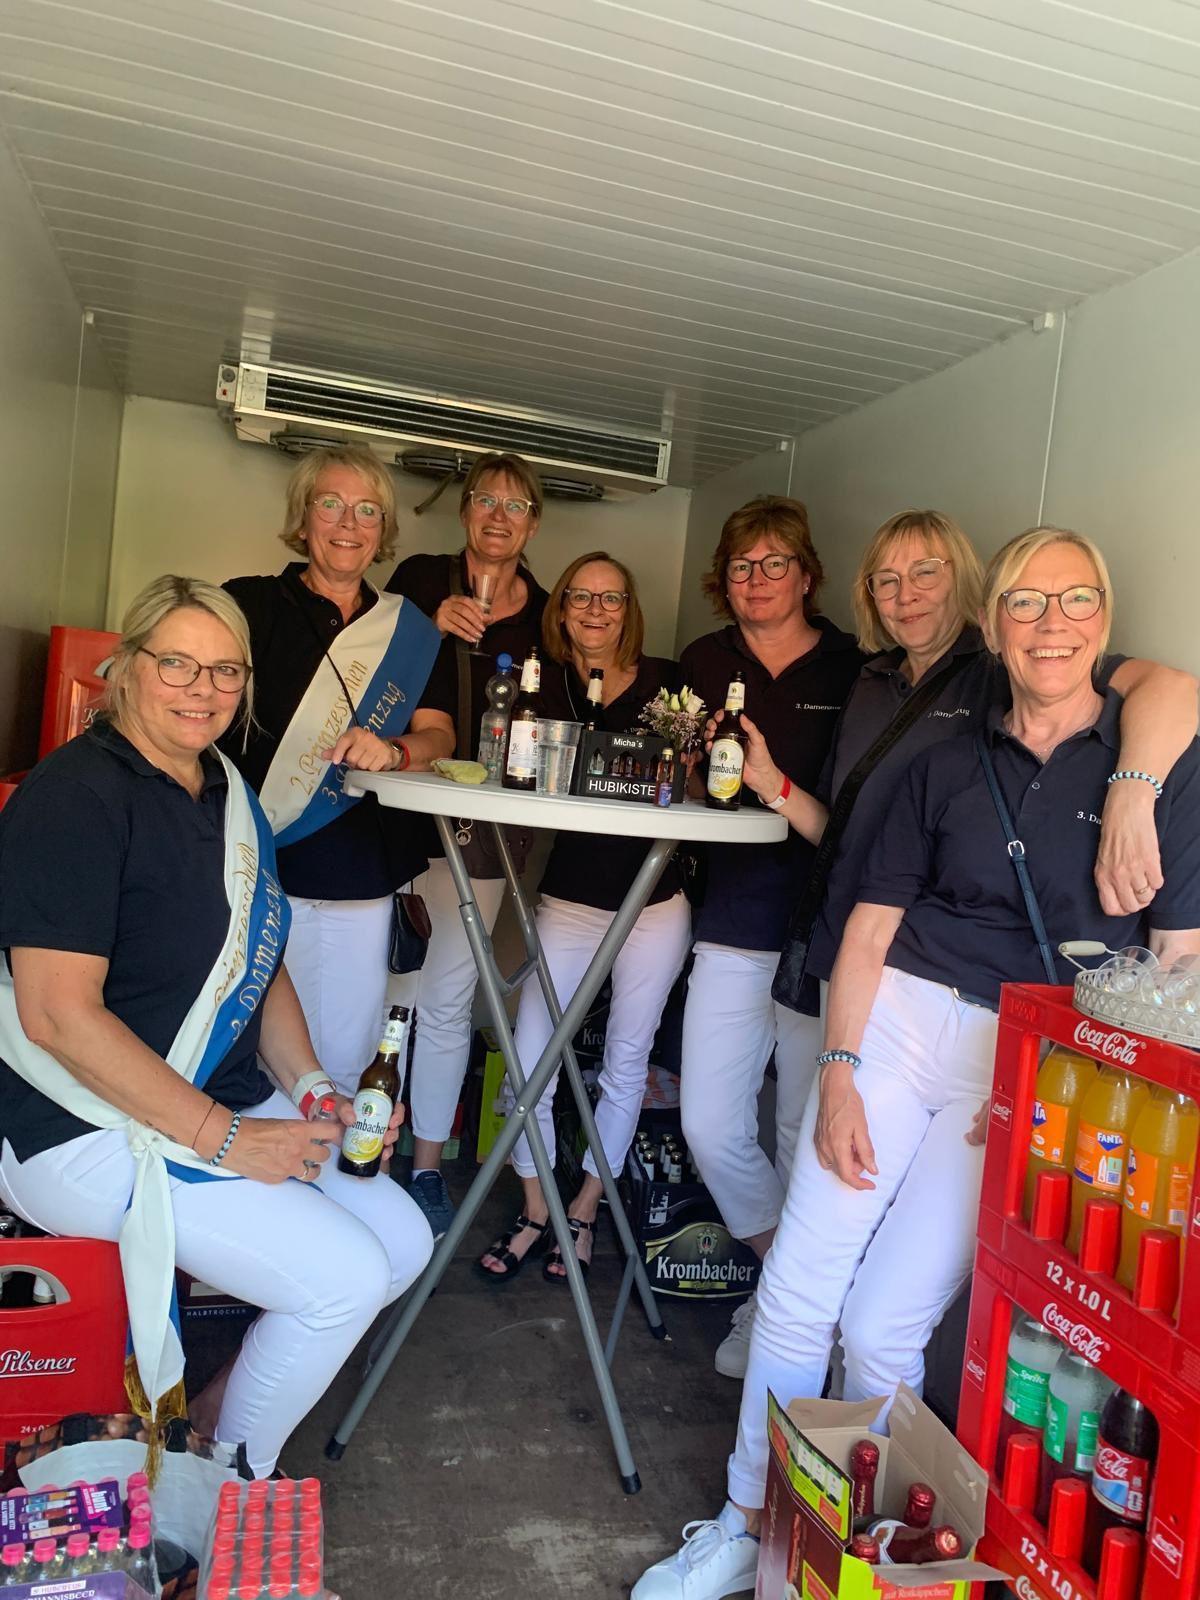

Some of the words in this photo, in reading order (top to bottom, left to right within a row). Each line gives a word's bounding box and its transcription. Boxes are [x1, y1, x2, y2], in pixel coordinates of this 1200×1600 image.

[708, 763, 743, 775] rombacher
[589, 779, 657, 797] HUBIKISTE
[1073, 1019, 1142, 1066] Coca-Cola
[348, 1118, 387, 1135] ombacher
[1097, 1132, 1124, 1145] FANTA
[656, 1255, 754, 1282] Krombacher
[1046, 1260, 1064, 1286] 12
[1077, 1283, 1101, 1311] 1.0
[1100, 1299, 1112, 1321] L
[1042, 1302, 1105, 1363] Coca-Cola
[0, 1348, 76, 1374] Pilsener
[1020, 1369, 1046, 1385] Sprite
[1021, 1536, 1038, 1564] 12
[1051, 1568, 1073, 1600] 1.0
